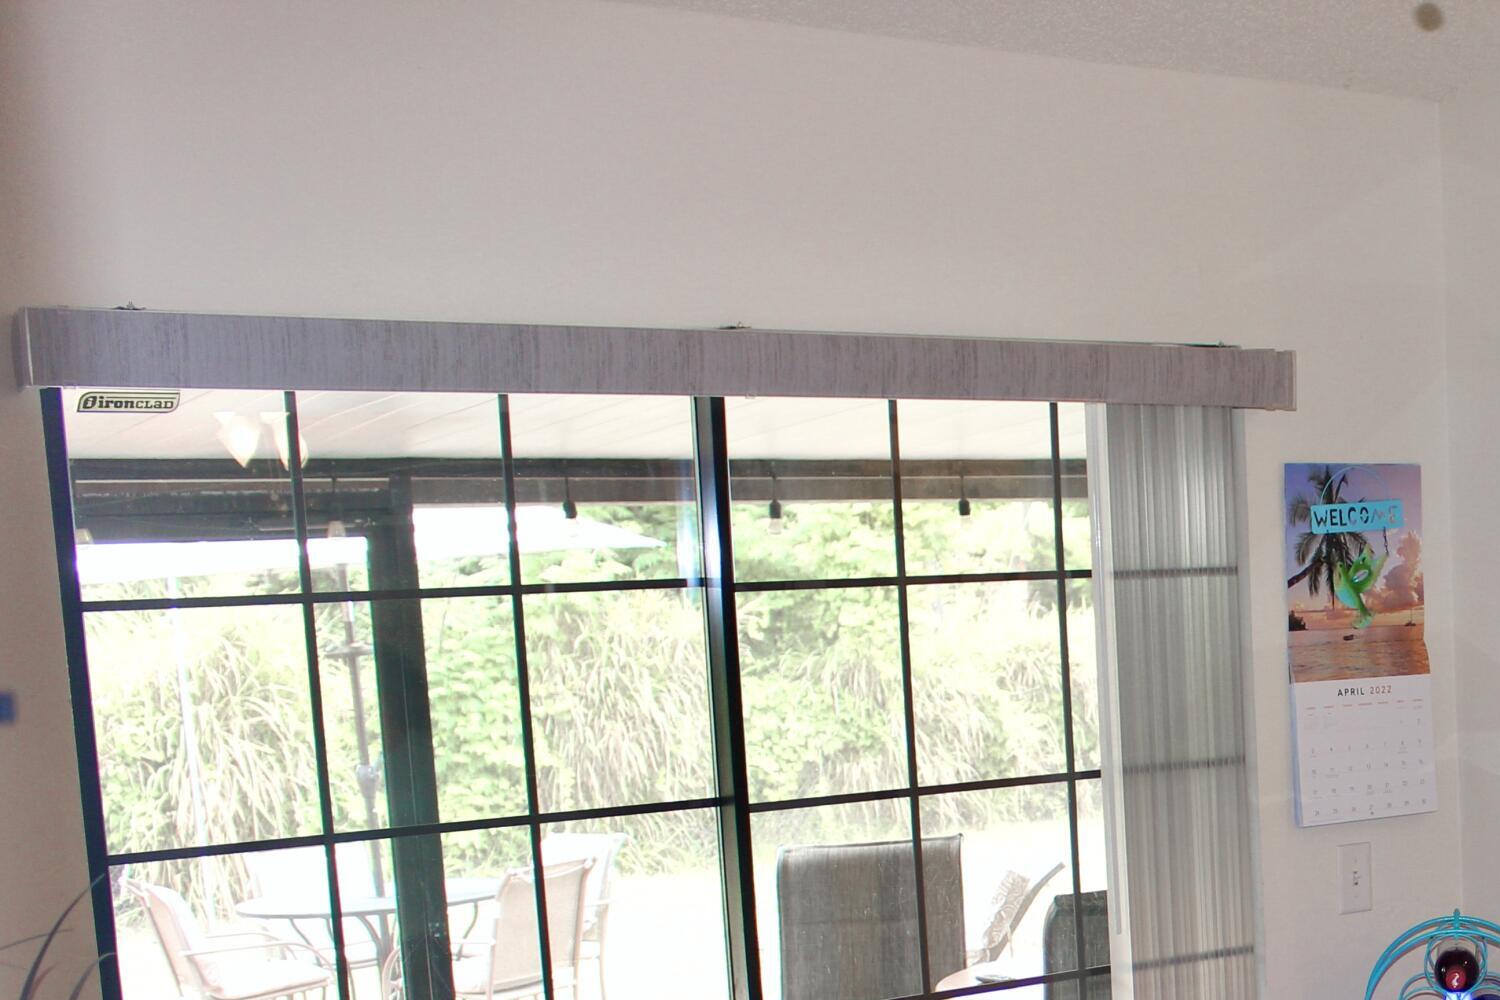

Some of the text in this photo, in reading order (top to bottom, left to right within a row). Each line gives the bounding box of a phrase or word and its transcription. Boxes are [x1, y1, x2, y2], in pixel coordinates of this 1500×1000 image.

[1313, 505, 1399, 527] WELCOME
[1337, 685, 1392, 697] APRIL 2022
